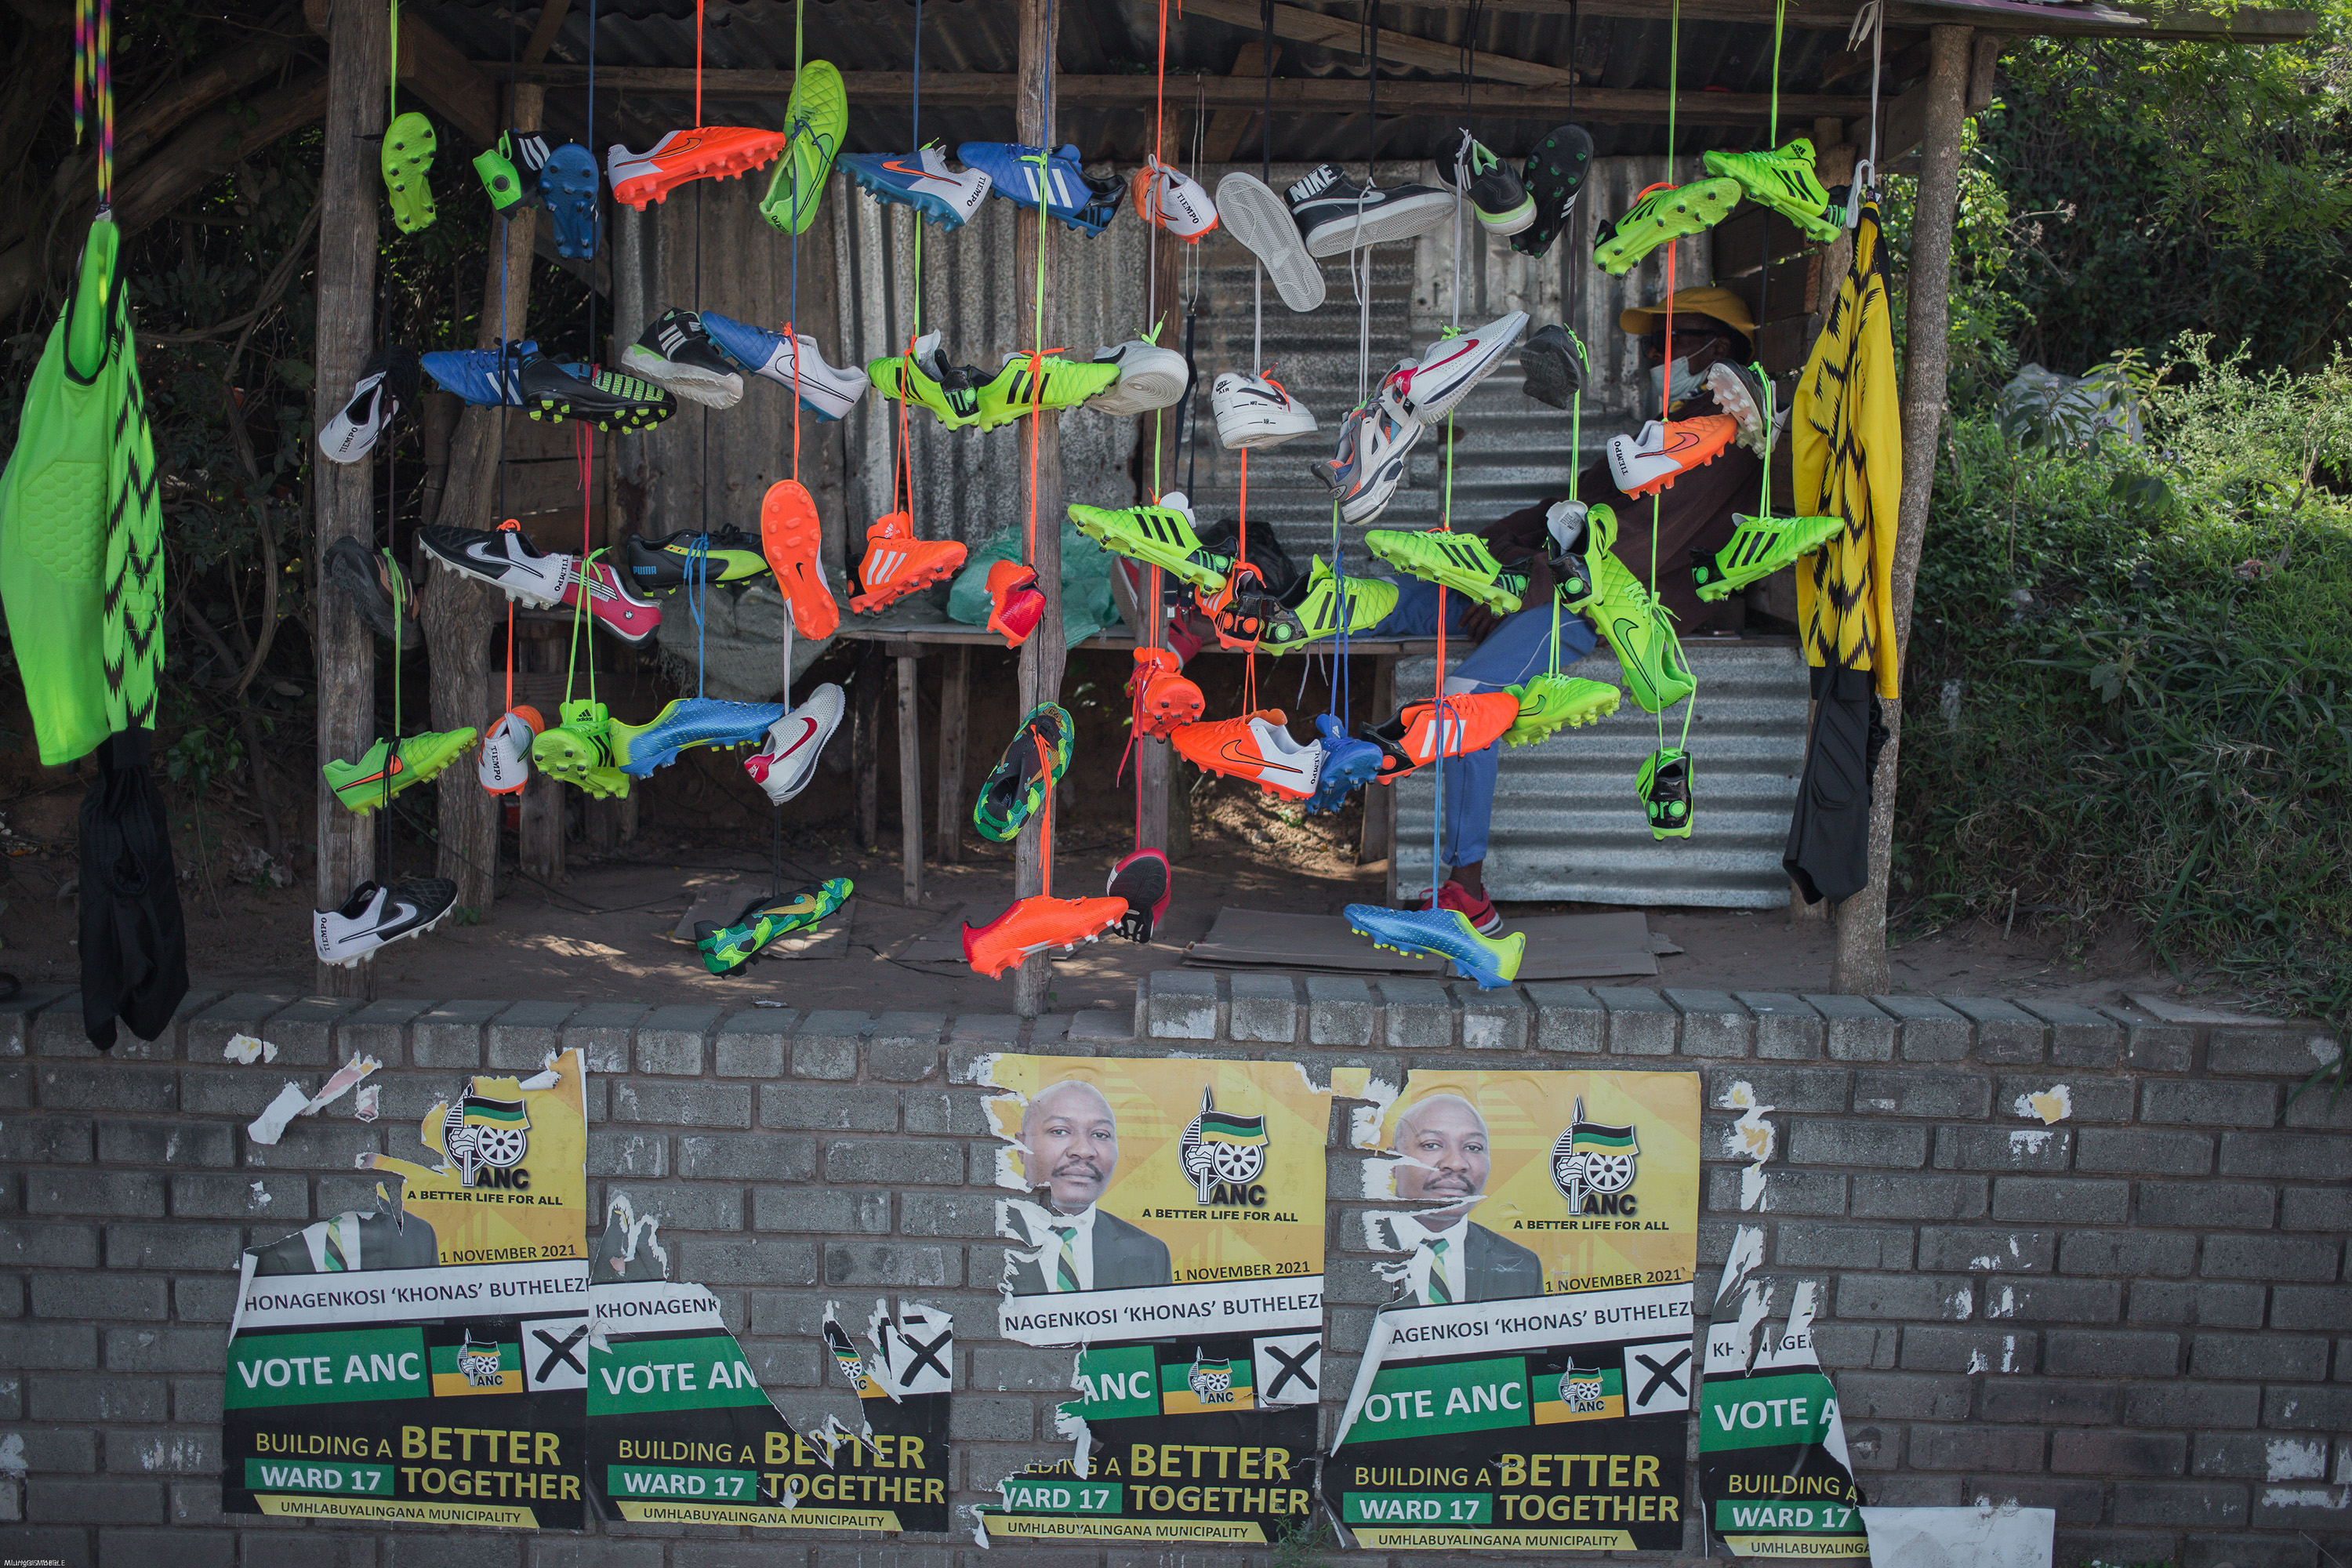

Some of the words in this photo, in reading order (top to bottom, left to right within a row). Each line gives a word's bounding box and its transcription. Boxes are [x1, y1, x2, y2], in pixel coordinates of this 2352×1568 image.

[967, 176, 986, 207] TIEMPO
[1290, 163, 1337, 201] NIKE
[1177, 192, 1200, 225] TIEMPO
[338, 426, 358, 453] TIEMPO
[1613, 441, 1629, 476] TIEMPO
[554, 557, 569, 592] TIEMPO
[633, 565, 657, 575] PUMA
[491, 746, 502, 781] TIEMPO
[321, 917, 330, 952] TIEMPO
[477, 1167, 529, 1189] ANC
[407, 1190, 416, 1200] A
[421, 1190, 471, 1202] BETTER
[476, 1192, 504, 1203] LIFE
[508, 1194, 534, 1204] FOR
[538, 1196, 563, 1206] ALL
[1211, 1184, 1265, 1206] ANC
[1583, 1193, 1636, 1216] ANC
[1142, 1209, 1151, 1218] A
[1156, 1209, 1207, 1221] BETTER
[1211, 1210, 1240, 1221] LIFE
[1243, 1211, 1269, 1221] FOR
[1273, 1212, 1298, 1222] ALL
[1513, 1220, 1523, 1229] A
[1527, 1220, 1578, 1231] BETTER
[1582, 1221, 1610, 1231] LIFE
[1614, 1221, 1640, 1231] FOR
[1644, 1221, 1669, 1231] ALL
[441, 1250, 447, 1263] 1
[453, 1246, 537, 1262] NOVEMBER
[542, 1244, 576, 1258] 2021
[1174, 1270, 1181, 1282] 1
[1186, 1263, 1272, 1281] NOVEMBER
[1276, 1261, 1310, 1275] 2021
[1545, 1280, 1553, 1293] 1
[1557, 1272, 1642, 1292] NOVEMBER
[1646, 1269, 1682, 1285] 2021
[1005, 1308, 1118, 1331] NAGENKOSI
[238, 1356, 333, 1388] VOTE
[343, 1352, 420, 1383] ANC
[477, 1374, 503, 1387] ANC
[600, 1363, 697, 1395] VOTE
[1207, 1391, 1234, 1404] ANC
[1445, 1381, 1522, 1416] ANC
[1578, 1399, 1605, 1414] ANC
[1714, 1397, 1809, 1432] VOTE
[256, 1432, 368, 1456] BUILDING
[376, 1439, 393, 1458] A
[401, 1425, 561, 1466] BETTER
[619, 1440, 732, 1463] BUILDING
[739, 1445, 756, 1464] A
[1105, 1457, 1122, 1476] A
[1131, 1443, 1290, 1480] BETTER
[1355, 1466, 1468, 1486] BUILDING
[1475, 1467, 1492, 1486] A
[1501, 1454, 1661, 1488] BETTER
[261, 1465, 343, 1490] WARD
[350, 1470, 381, 1490] 17
[401, 1467, 581, 1501] TOGETHER
[624, 1472, 706, 1496] WARD
[714, 1477, 744, 1497] 17
[764, 1472, 946, 1504] TOGETHER
[1728, 1474, 1840, 1495] BUILDING
[1845, 1485, 1857, 1501] A
[1079, 1488, 1109, 1510] 17
[1130, 1485, 1310, 1515] TOGETHER
[1359, 1499, 1442, 1520] WARD
[1450, 1500, 1479, 1520] 17
[1499, 1494, 1679, 1523] TOGETHER
[281, 1501, 424, 1520] UMHLABUYALINGANA
[429, 1509, 521, 1523] MUNICIPALITY
[643, 1508, 787, 1525] UMHLABUYALINGANA
[790, 1512, 884, 1528] MUNICIPALITY
[1733, 1507, 1813, 1528] WARD
[1821, 1508, 1852, 1528] 17
[1007, 1521, 1152, 1537] UMHLABUYALINGANA
[1156, 1523, 1248, 1539] MUNICIPALITY
[1378, 1534, 1522, 1547] UMHLABUYALINGANA
[1525, 1534, 1619, 1548] MUNICIPALITY
